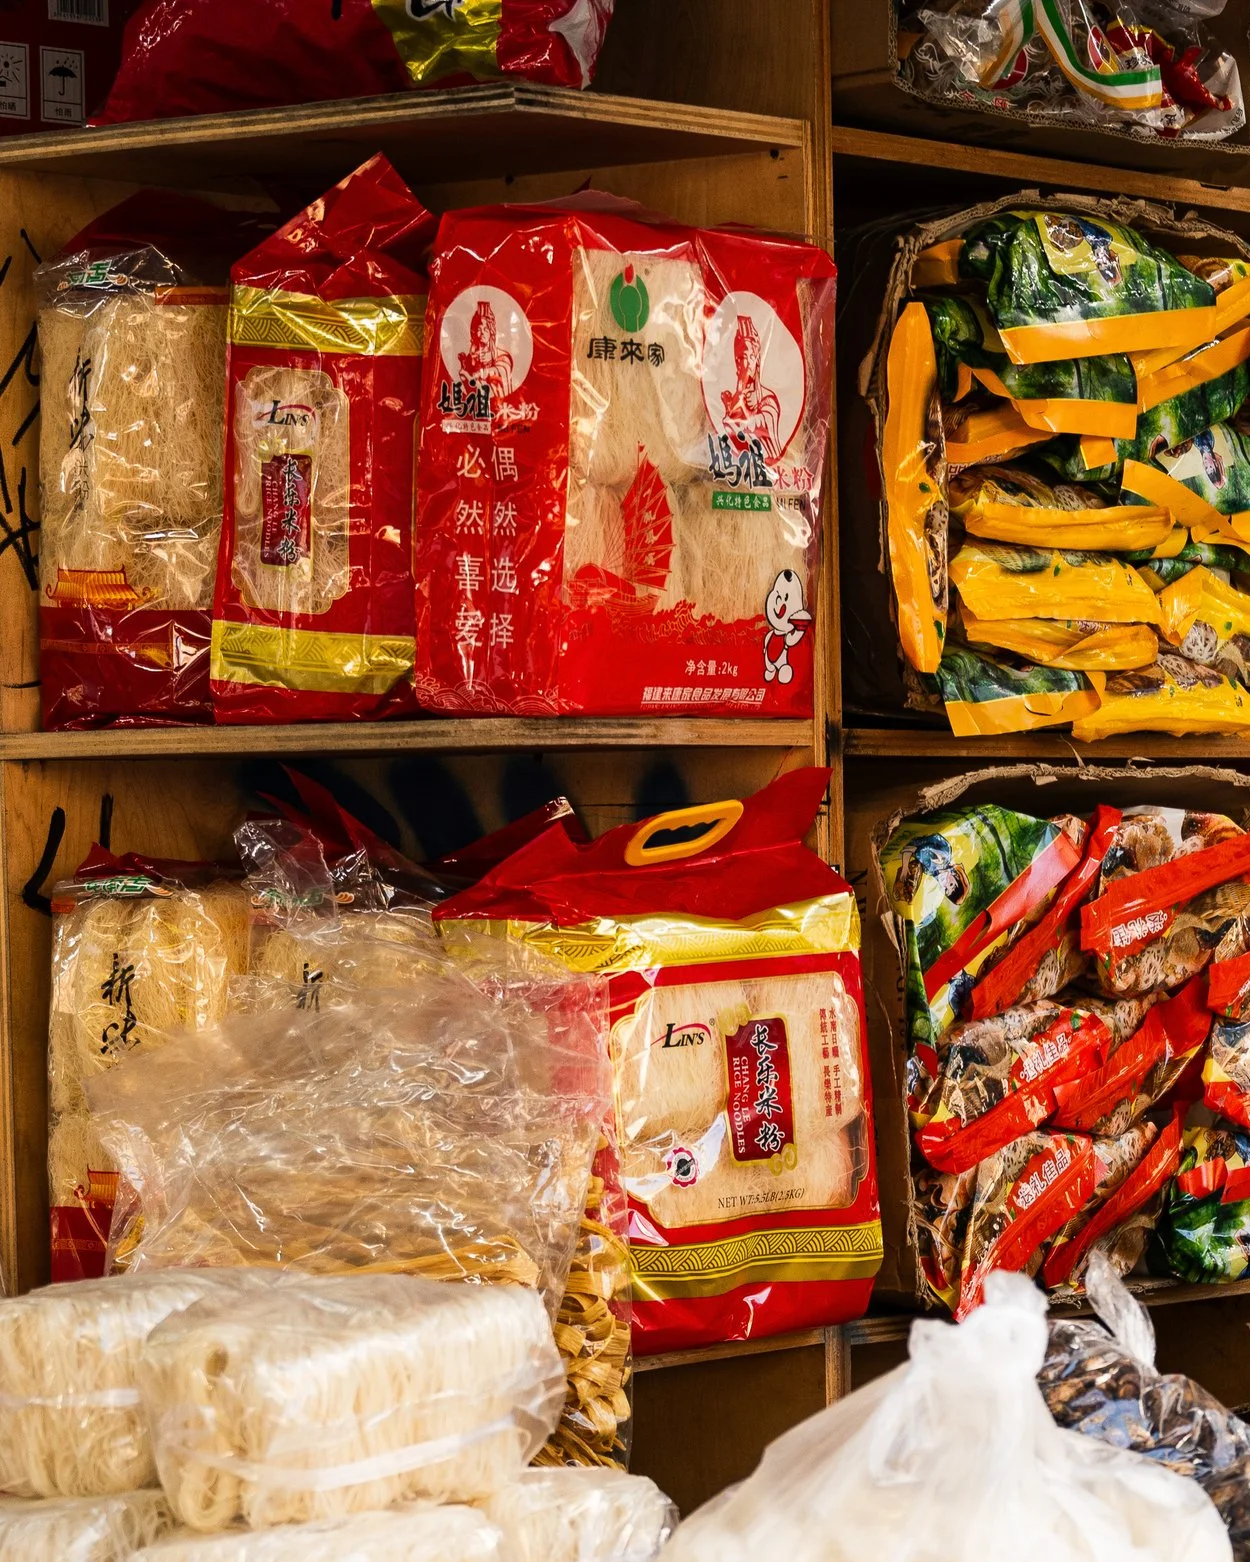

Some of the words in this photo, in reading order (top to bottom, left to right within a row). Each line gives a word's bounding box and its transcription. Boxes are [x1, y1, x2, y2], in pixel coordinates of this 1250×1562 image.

[587, 335, 664, 367] 康來家
[773, 466, 815, 491] 米粉
[716, 495, 769, 508] 兴化特色食品
[455, 444, 487, 647] 必然喜爱
[490, 446, 519, 649] 偶然选择
[684, 659, 738, 677] 净含量:2kg
[661, 1022, 705, 1048] LIN'S
[732, 1056, 741, 1089] RICE
[741, 1056, 751, 1106] CHANG
[750, 1023, 785, 1152] 长乐米粉
[734, 1093, 745, 1154] NOODLES
[742, 1107, 750, 1122] LE
[1017, 1149, 1071, 1210] 送礼佳品
[718, 1197, 737, 1209] NET
